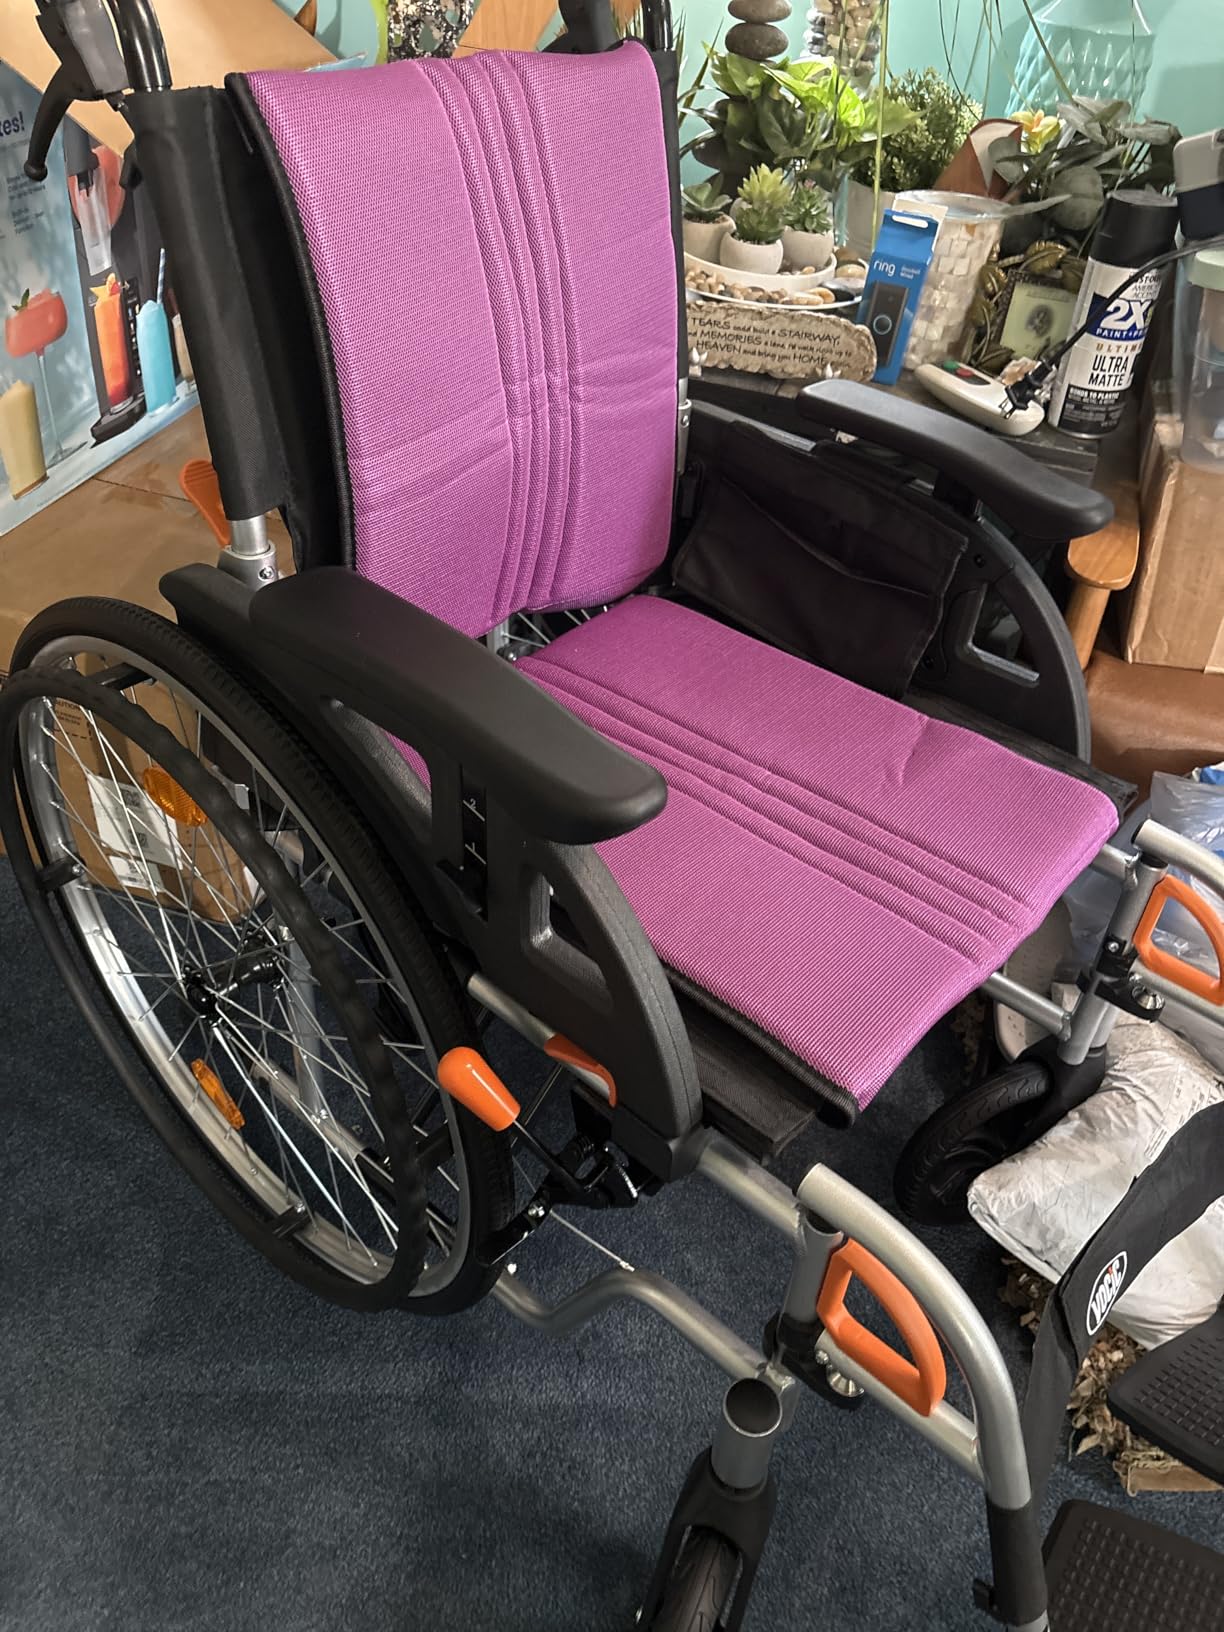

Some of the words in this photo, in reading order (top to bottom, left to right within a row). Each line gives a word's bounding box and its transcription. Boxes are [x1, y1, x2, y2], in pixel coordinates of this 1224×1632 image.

[873, 260, 896, 277] ring
[1100, 299, 1152, 331] 2X
[691, 317, 731, 330] TEARS
[778, 328, 840, 348] STAIRWAY,
[700, 329, 762, 346] MEMORIES
[696, 339, 741, 353] HEAVEN
[793, 352, 827, 366] HOME
[1092, 354, 1129, 373] ULTRA
[1088, 372, 1125, 387] MATTE
